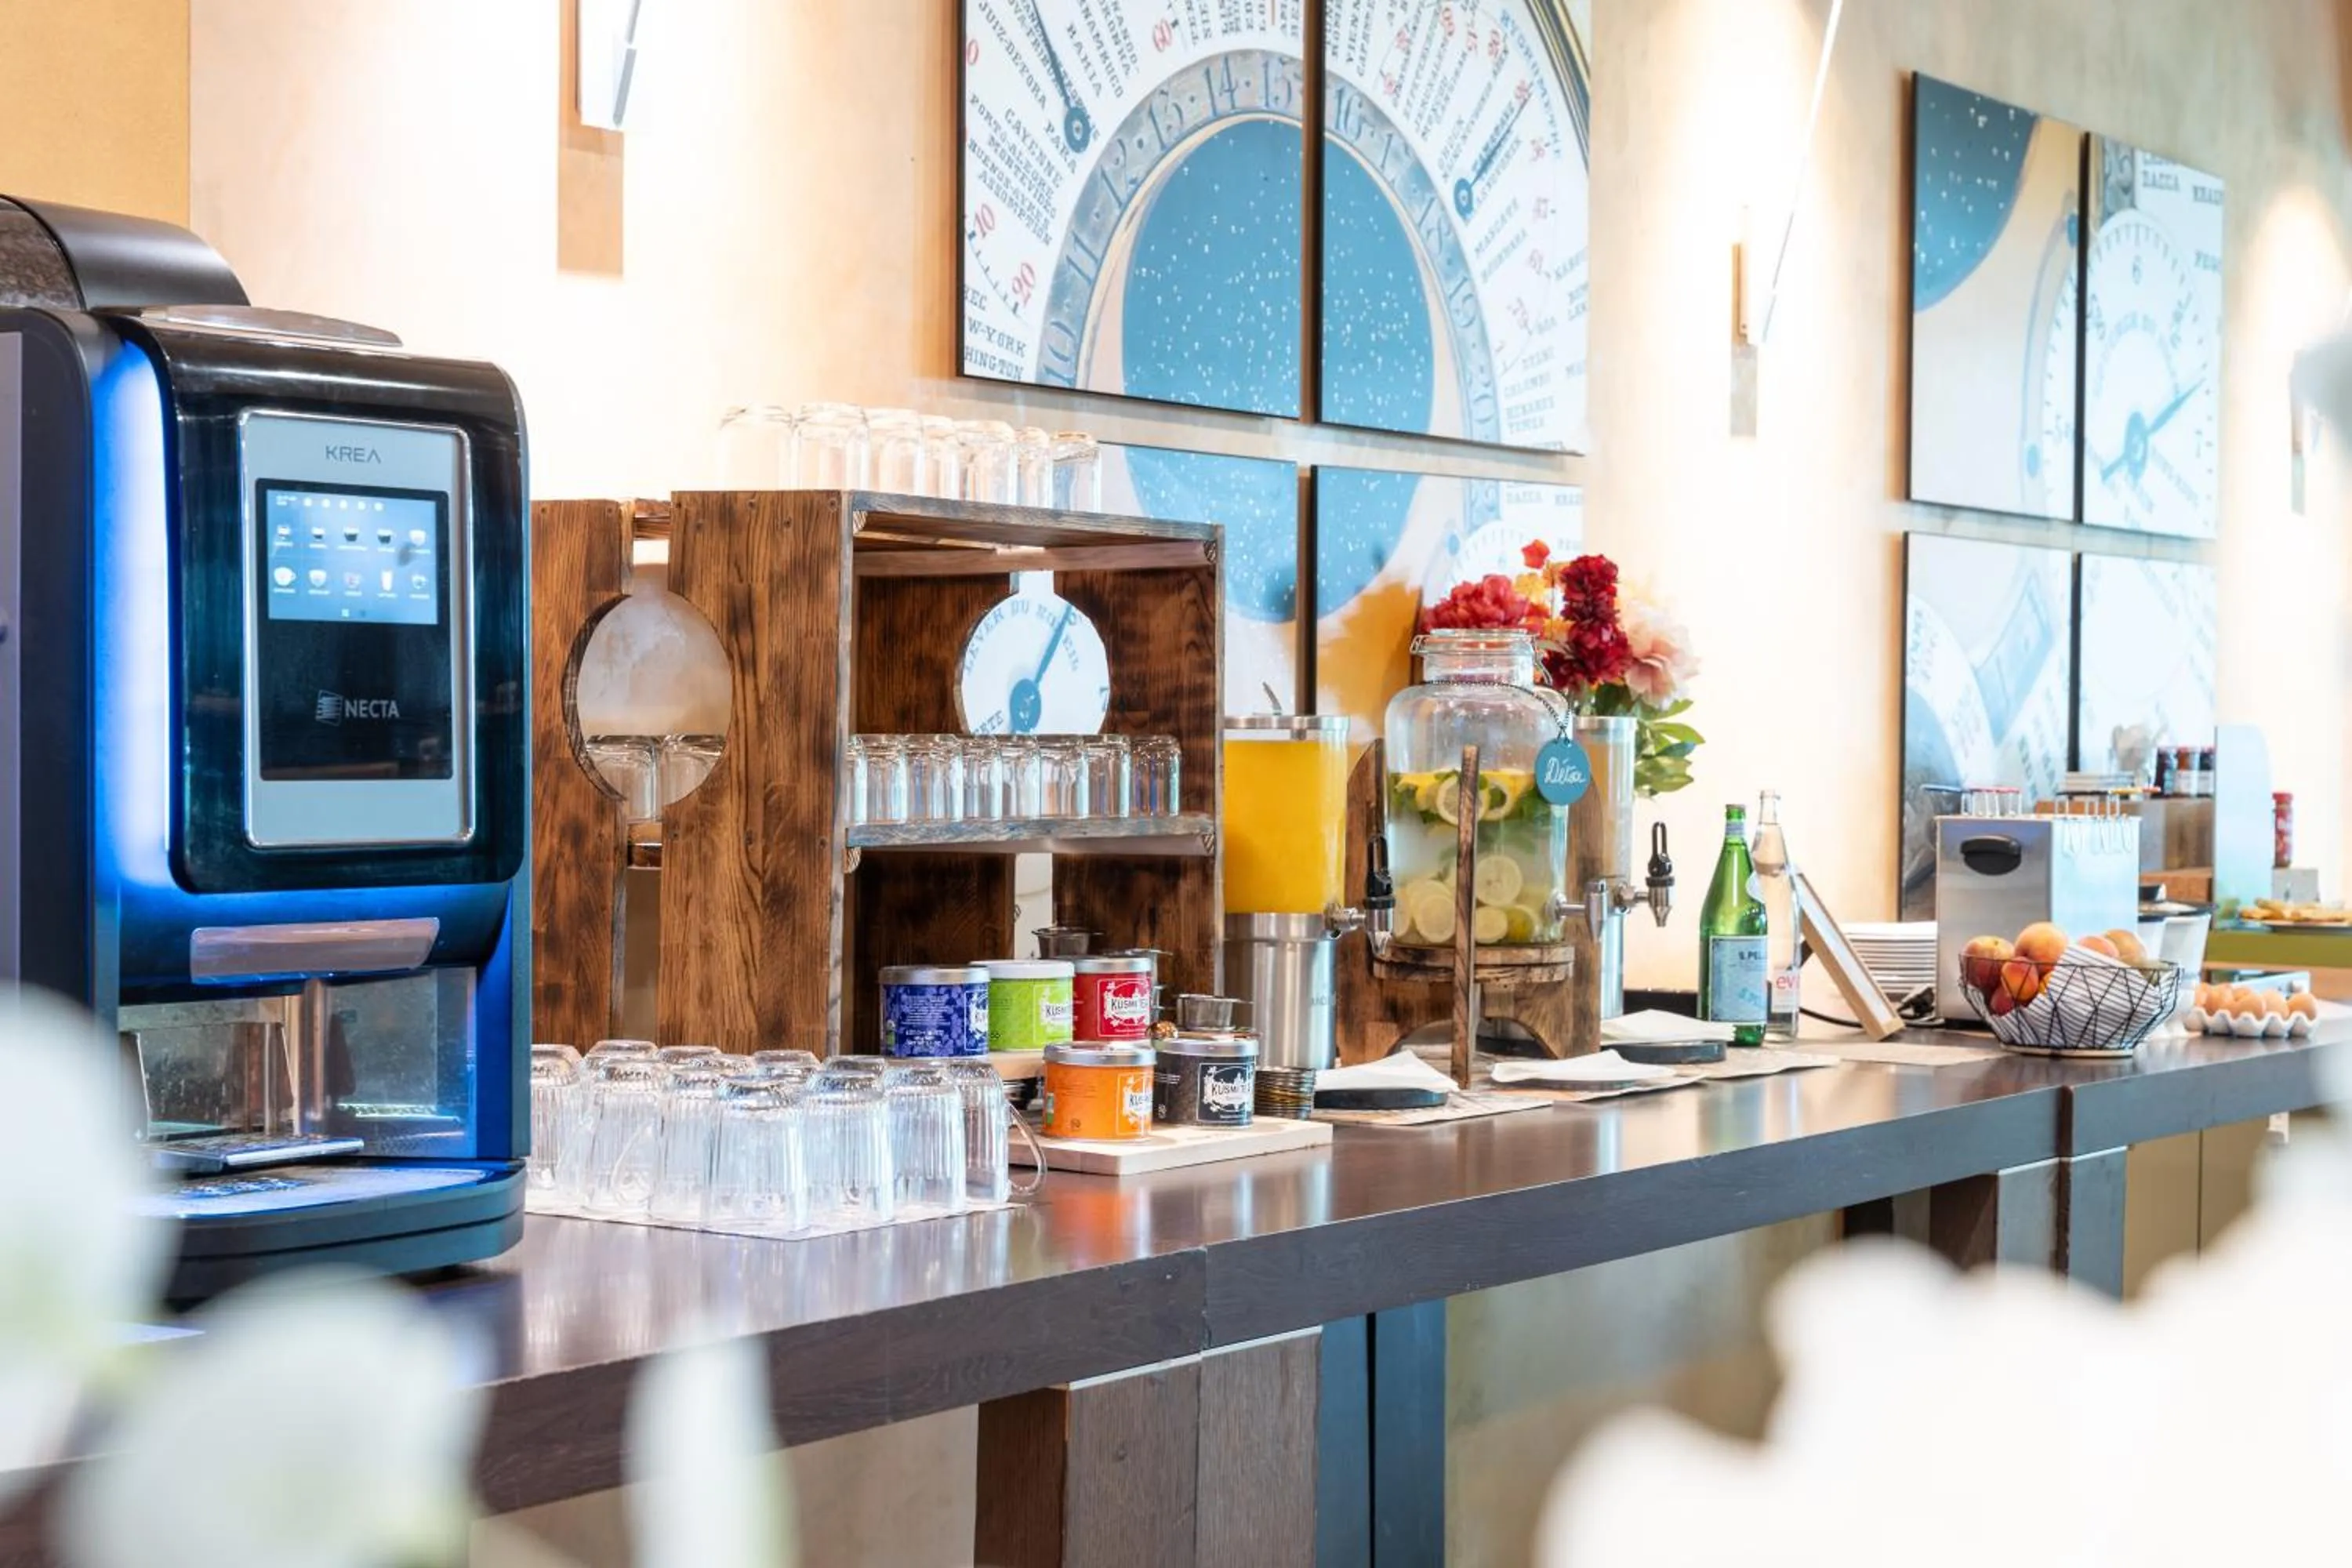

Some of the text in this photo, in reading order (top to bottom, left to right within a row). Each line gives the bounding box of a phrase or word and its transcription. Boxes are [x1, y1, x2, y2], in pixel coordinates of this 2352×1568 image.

[1203, 54, 1240, 118] 14
[975, 203, 995, 238] 10
[325, 445, 382, 464] KREA
[344, 699, 401, 719] NECTA
